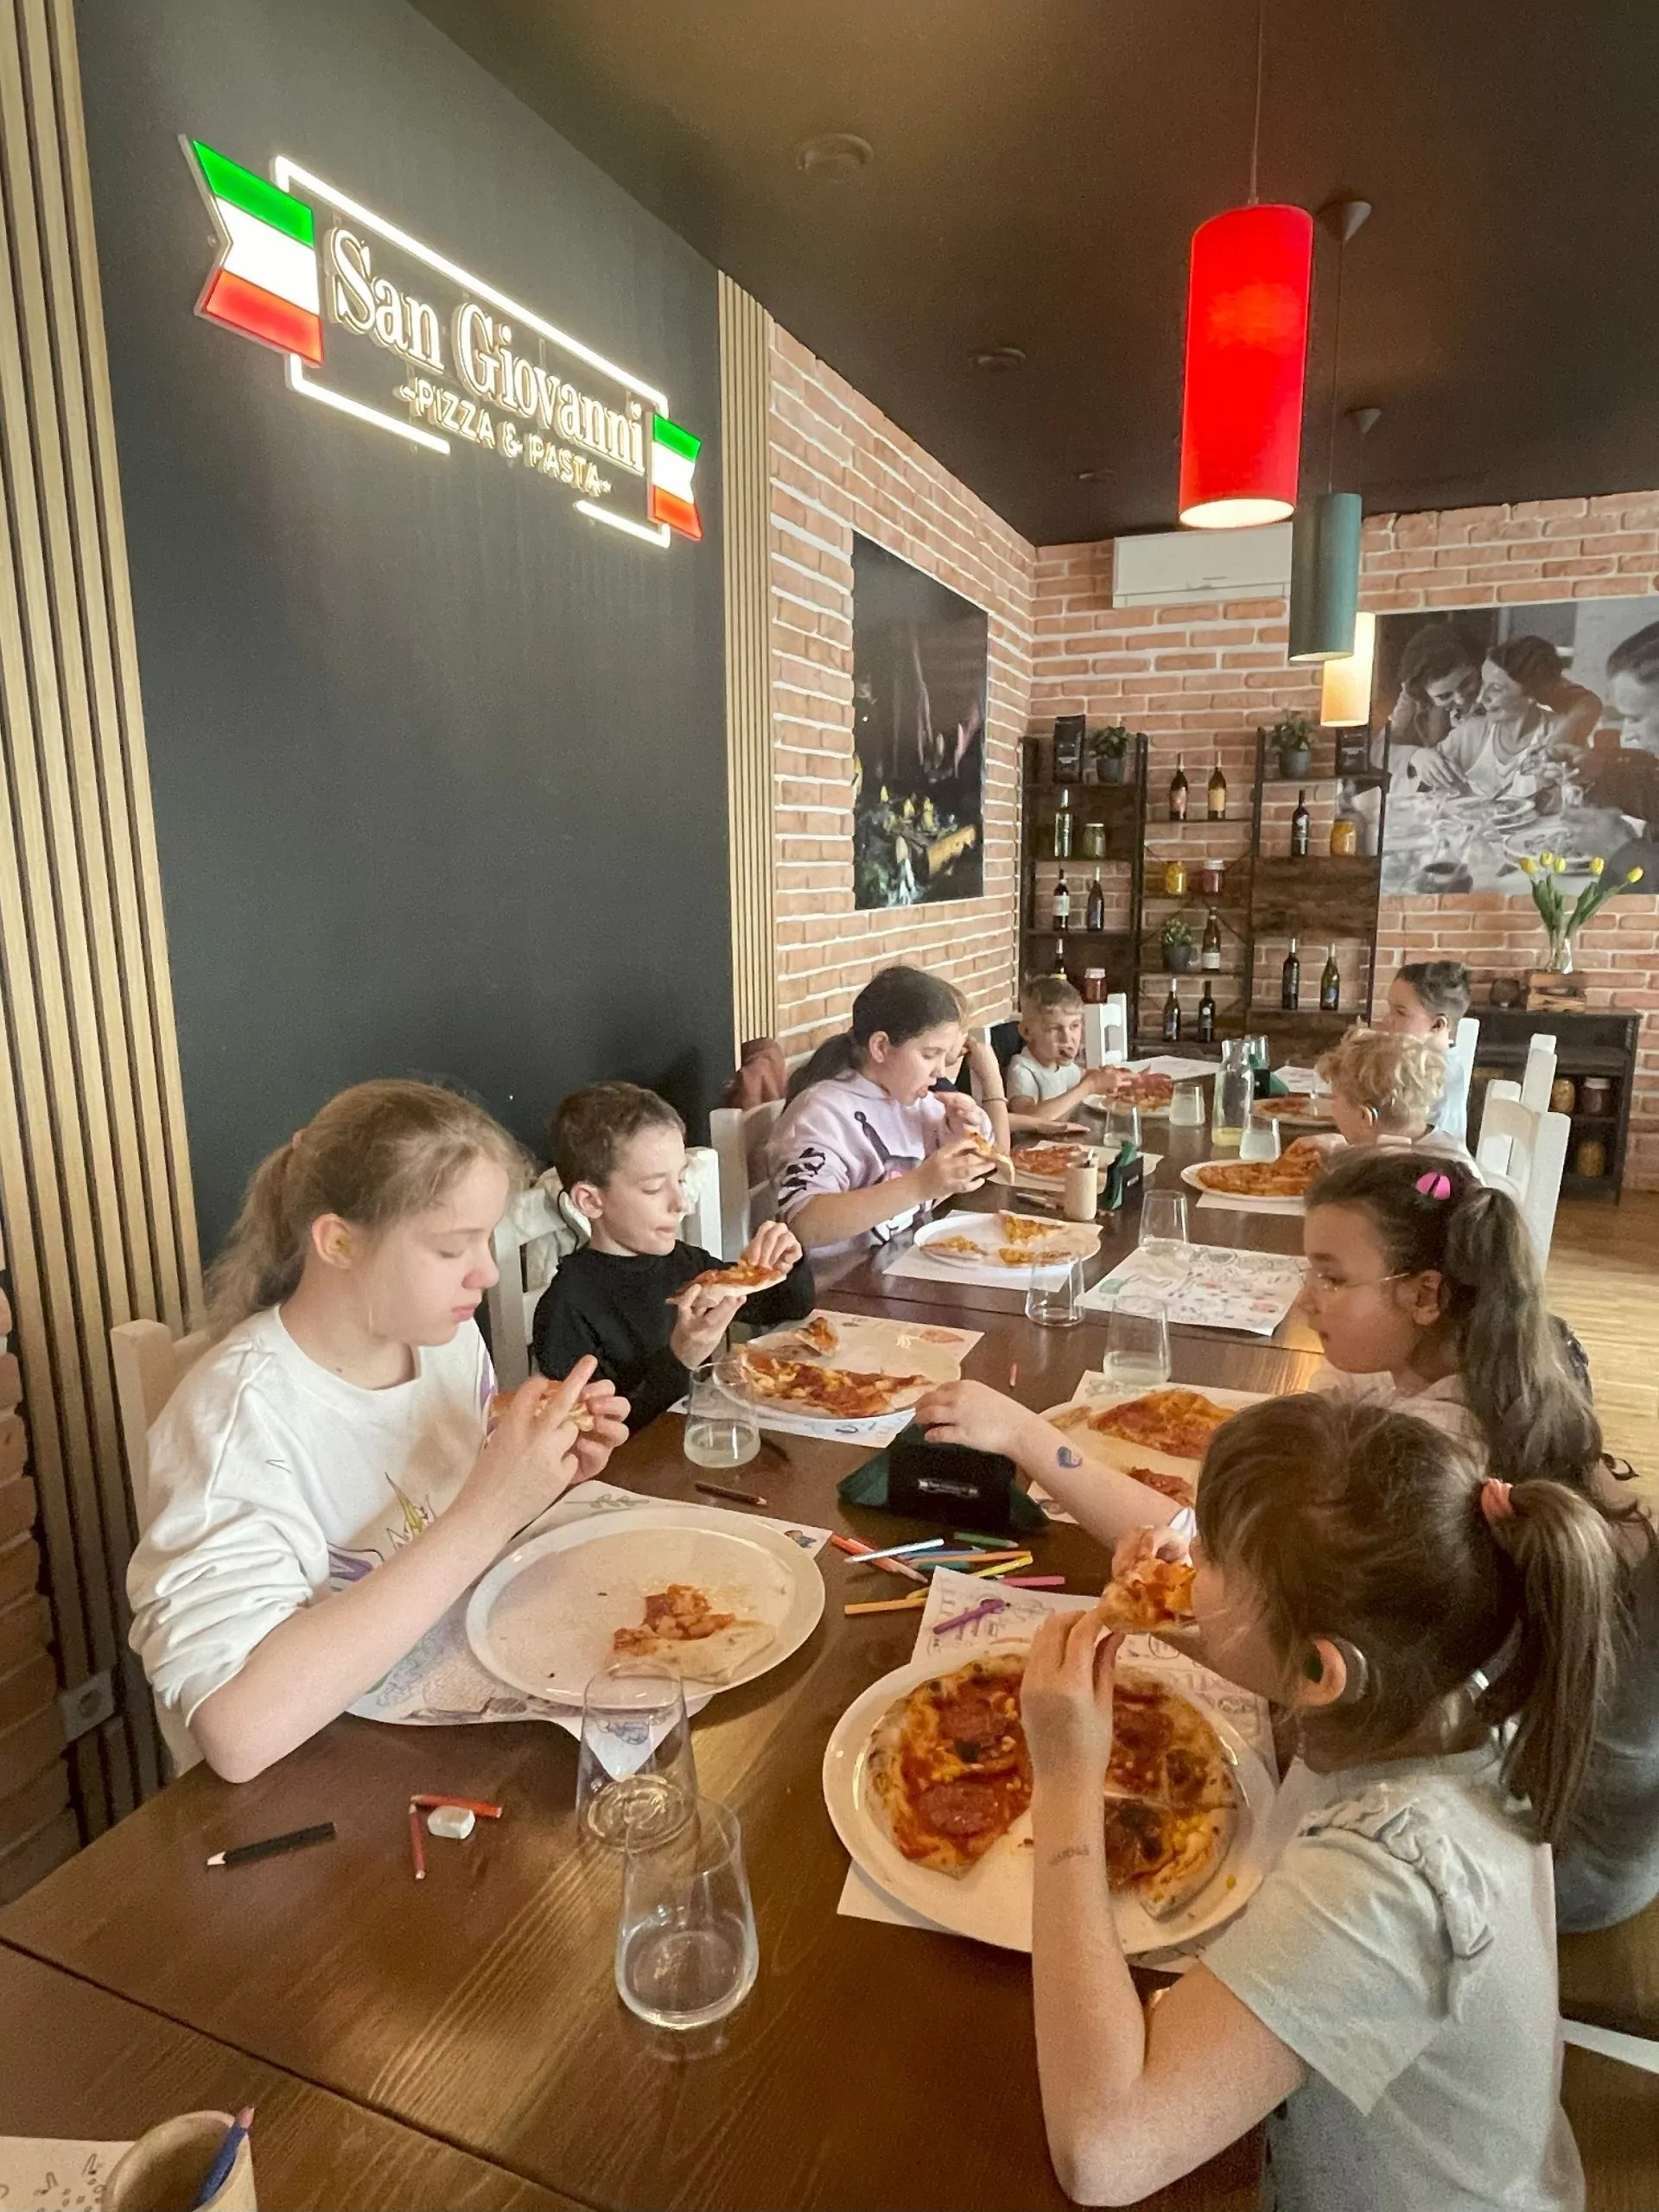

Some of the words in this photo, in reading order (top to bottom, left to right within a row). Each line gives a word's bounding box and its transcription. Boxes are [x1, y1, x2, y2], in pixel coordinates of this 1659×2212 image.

[328, 227, 446, 375] San
[454, 302, 646, 476] Giovanni
[411, 377, 496, 449] PIZZA
[498, 421, 524, 460] &
[525, 432, 602, 498] PASTA
